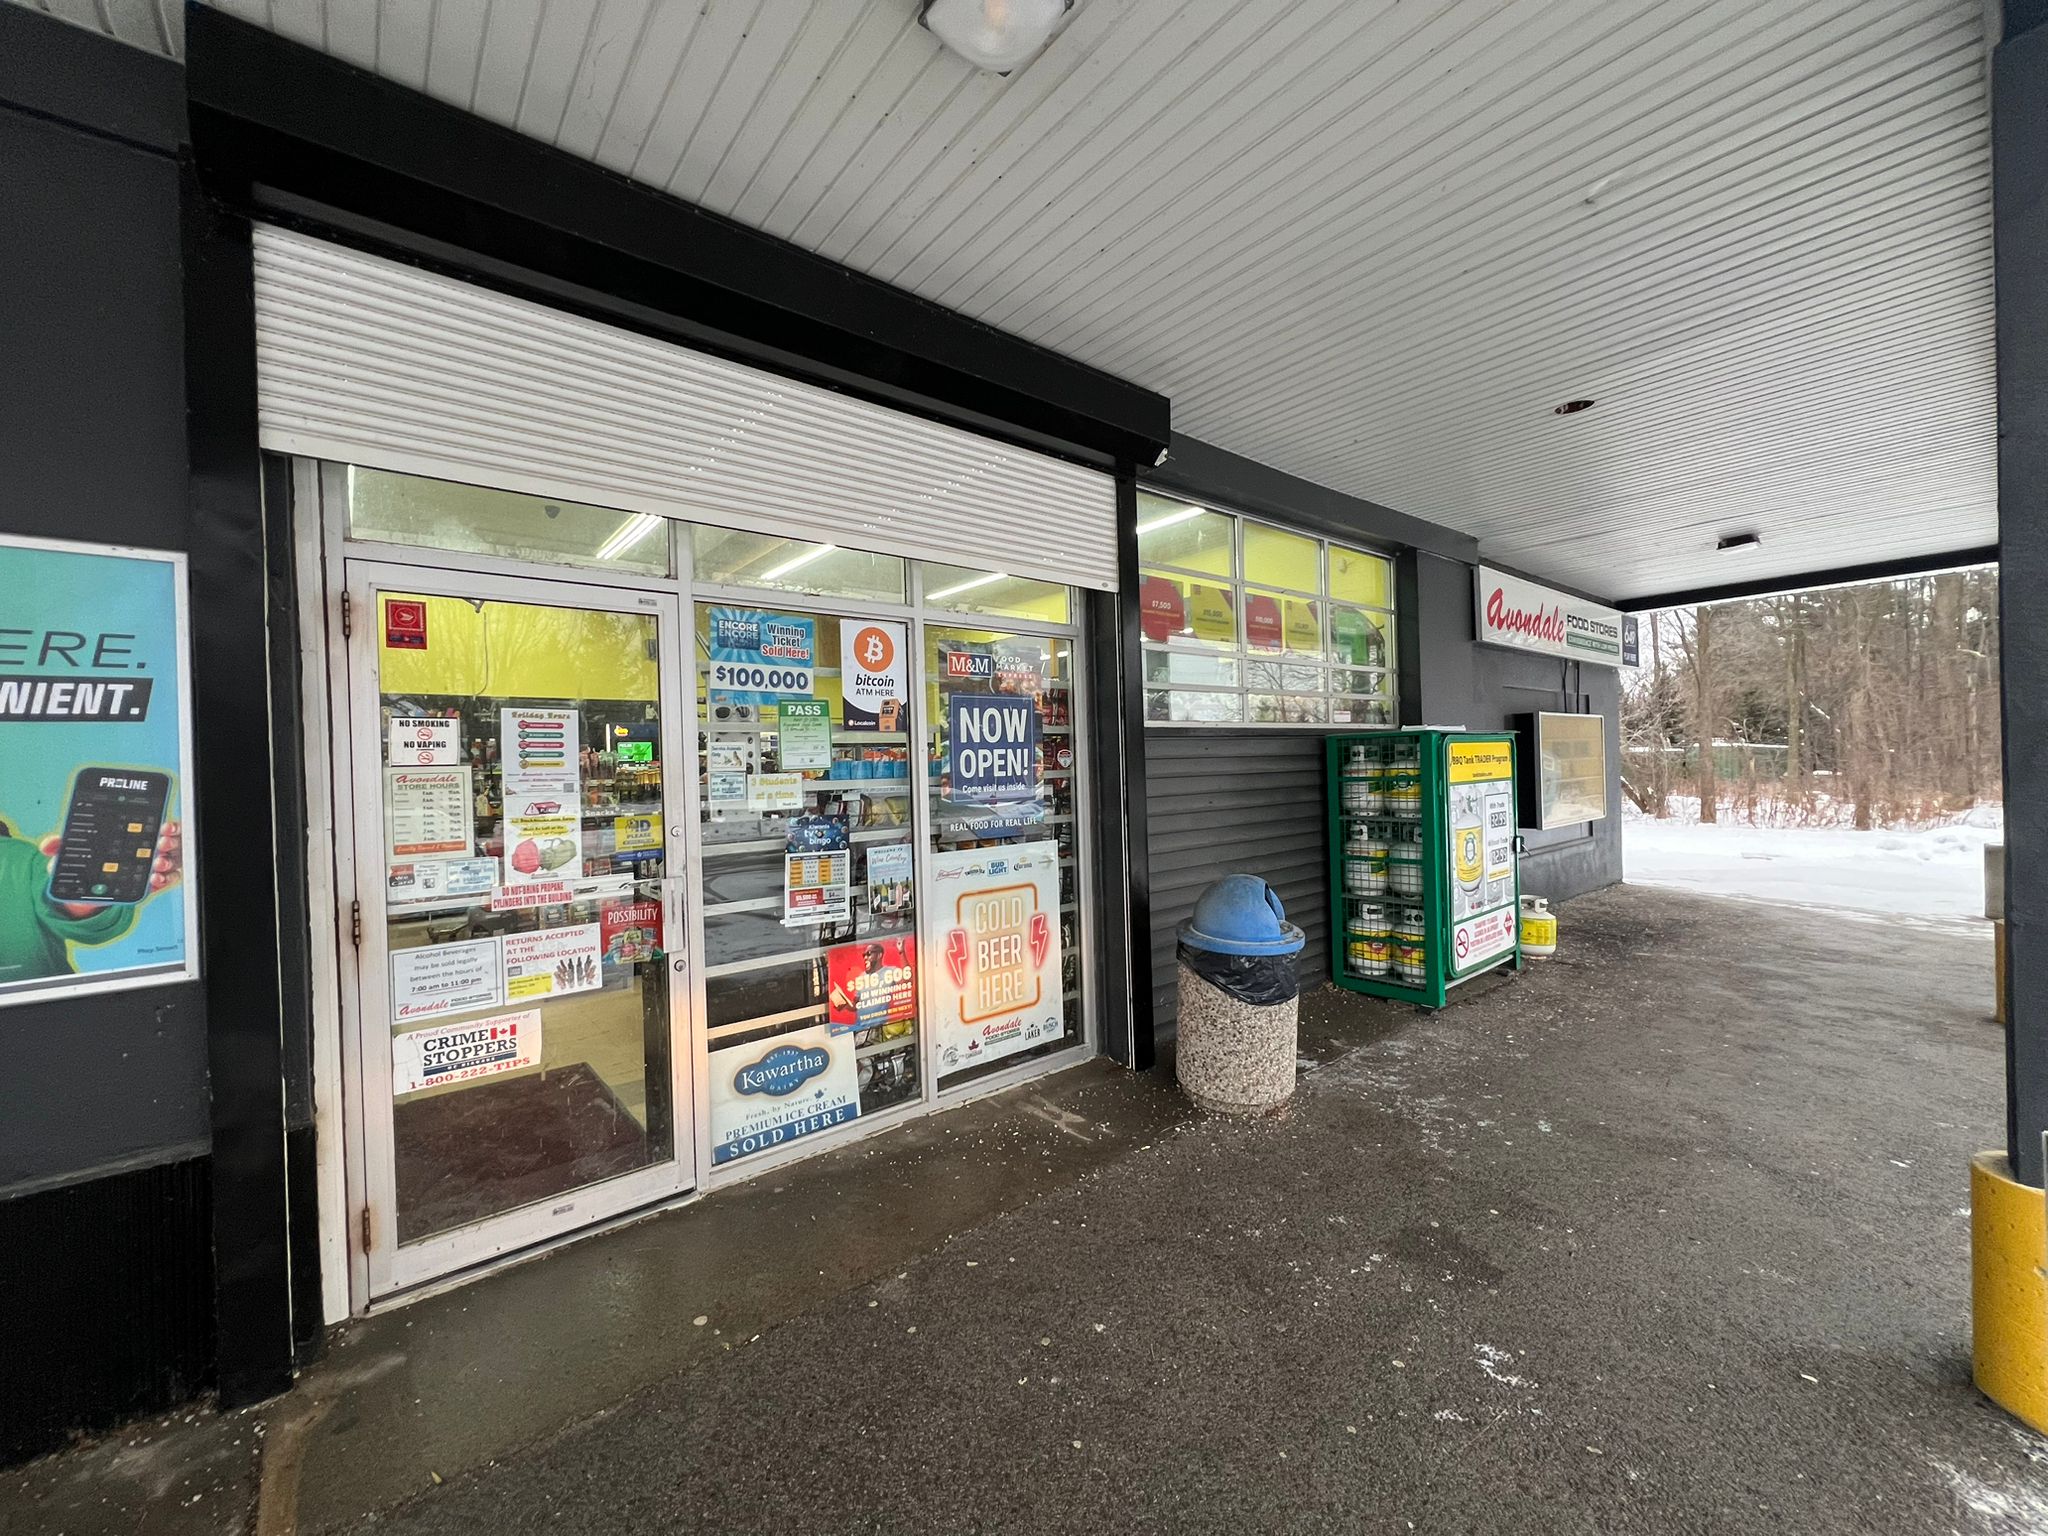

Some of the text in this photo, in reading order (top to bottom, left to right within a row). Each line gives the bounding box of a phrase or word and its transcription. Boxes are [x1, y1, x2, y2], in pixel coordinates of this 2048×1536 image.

[1487, 587, 1564, 643] Avondale
[719, 620, 758, 632] ENCORE
[767, 623, 805, 638] Winning
[1566, 614, 1618, 639] FOOD STORES
[719, 629, 759, 640] ENCORE
[772, 635, 801, 647] Ticket
[762, 644, 809, 659] Sold Here!
[950, 655, 990, 674] M&M
[716, 665, 809, 690] $100,000
[856, 673, 895, 687] bitcoin
[0, 681, 140, 715] NIENT.
[856, 688, 895, 697] ATM HERE
[787, 705, 822, 716] PASS
[399, 719, 450, 728] NO SMOKING
[960, 707, 1028, 744] NOW
[403, 740, 447, 749] NO VAPING
[960, 748, 1029, 779] OPEN!
[1451, 754, 1508, 765] BBQ Tank TRADER Program
[99, 776, 149, 791] PROLINE
[395, 775, 457, 785] Avondale
[758, 777, 798, 786] Students
[962, 784, 982, 793] Come
[983, 784, 997, 793] visit
[1006, 782, 1026, 791] inside
[950, 816, 1037, 832] REAL FOOD FOR REAL LIFE
[809, 837, 832, 846] bingo
[988, 866, 1007, 875] LIGHT
[391, 879, 414, 887] Card
[501, 882, 564, 897] DO NOT BRING PROPANE
[493, 891, 572, 909] CYLINDERS INTO THE BUILDING
[607, 908, 658, 926] POSSIBILITY
[975, 896, 1022, 934] COLD
[506, 929, 585, 946] RETURNS ACCEPTED
[415, 947, 477, 960] Alcohol Beverages
[506, 945, 596, 965] FOLLOWING LOCATION
[520, 945, 535, 954] THE
[977, 934, 1022, 973] BEER
[457, 957, 479, 965] legally
[410, 973, 441, 983] between
[442, 970, 454, 978] the
[455, 967, 474, 976] hours
[411, 985, 427, 993] 7:00
[450, 978, 469, 987] 11:00
[860, 981, 913, 1000] IN WINNINGS
[979, 968, 1024, 1009] HERE
[399, 999, 449, 1016] Avondale
[855, 990, 912, 1010] CLAIMED HERE
[415, 1030, 439, 1040] Proud
[440, 1022, 484, 1035] Community
[484, 1014, 522, 1027] Supporter
[982, 1016, 1022, 1037] Avondale
[1024, 1028, 1040, 1040] LAKER
[423, 1029, 489, 1052] CRIME
[423, 1037, 518, 1067] STOPPERS
[409, 1057, 531, 1090] 1-800-222-TIPS
[742, 1054, 823, 1090] Kawartha
[771, 1104, 782, 1114] by
[725, 1095, 847, 1141] PREMIUM ICE CREAM
[729, 1108, 846, 1158] SOLD HERE
